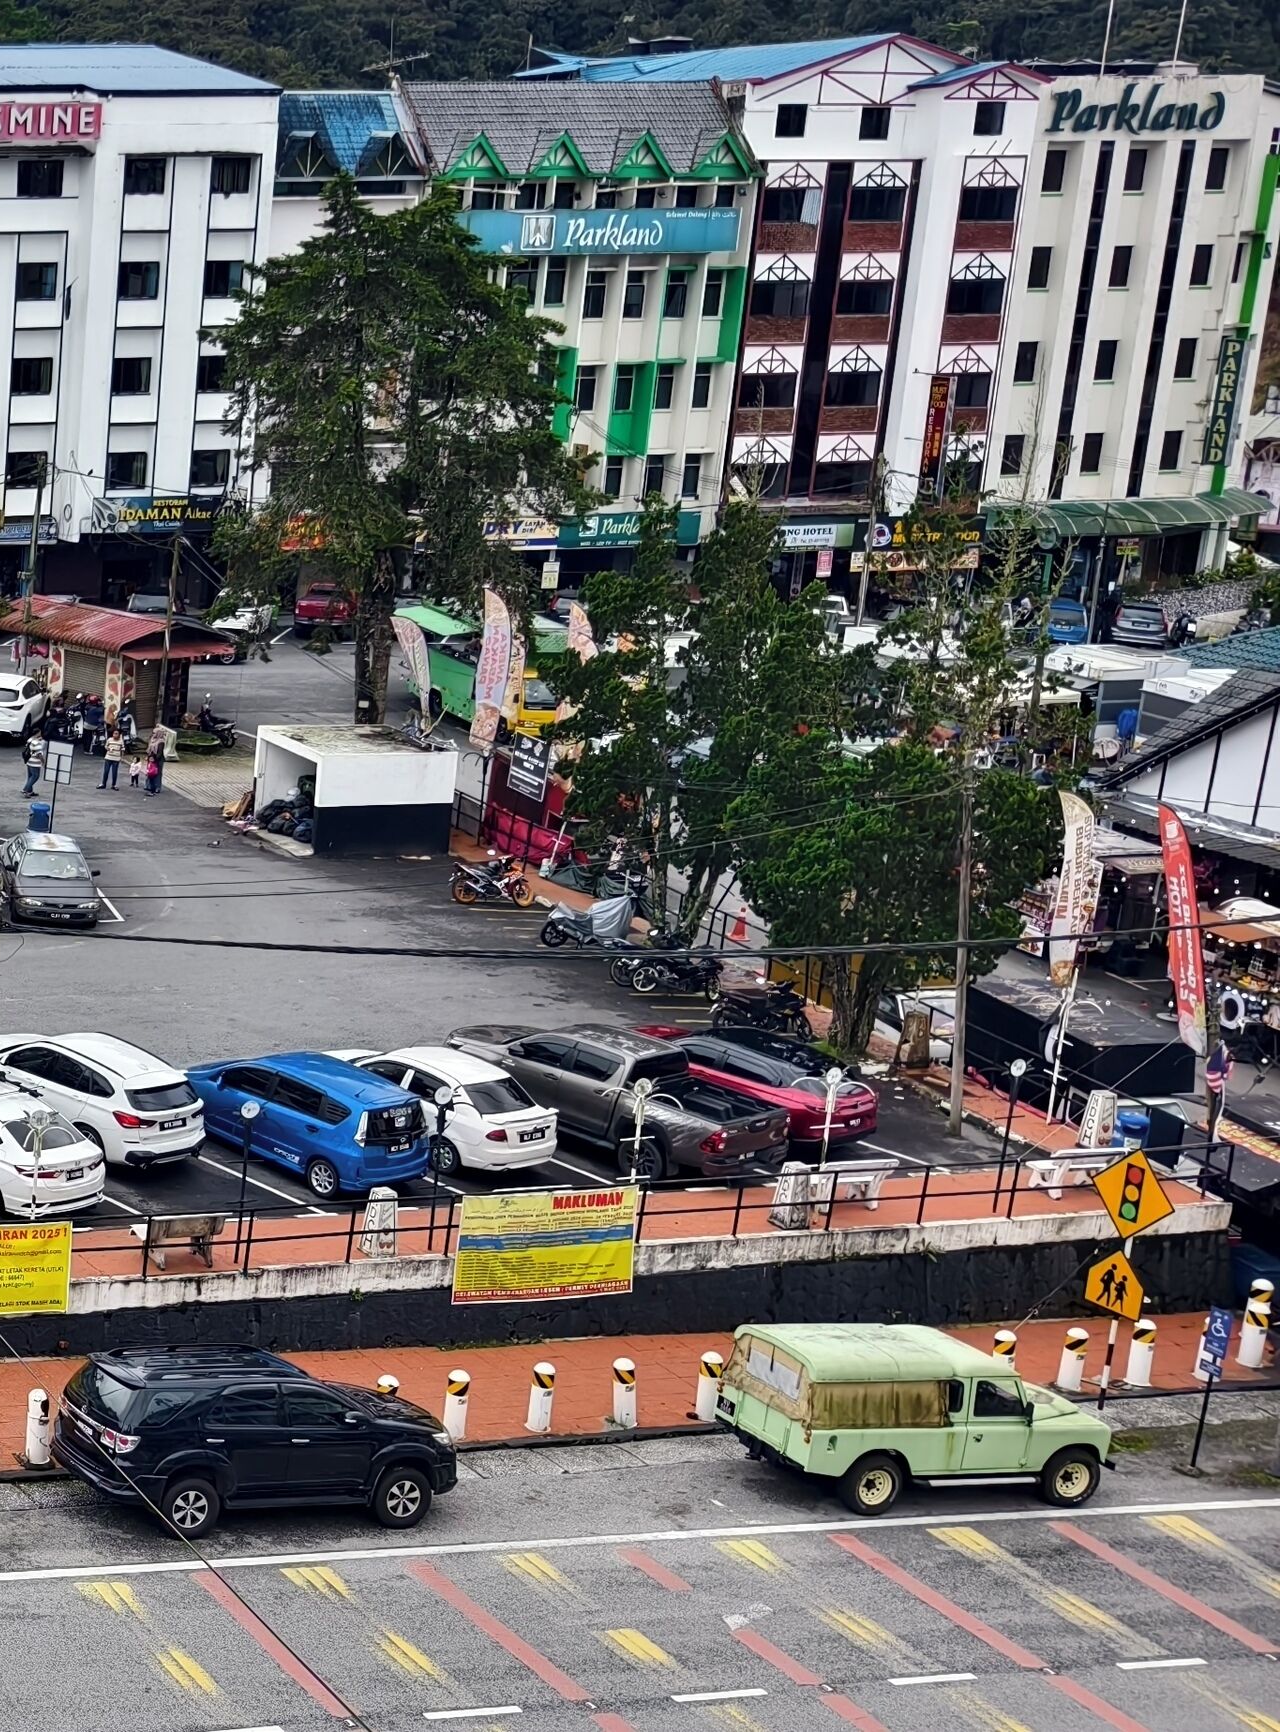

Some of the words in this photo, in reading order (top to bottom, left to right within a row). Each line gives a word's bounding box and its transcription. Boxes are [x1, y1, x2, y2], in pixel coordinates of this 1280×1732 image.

[1045, 82, 1226, 136] Parkland
[563, 215, 663, 250] Parkland
[1208, 341, 1241, 463] PARKLAND
[119, 508, 181, 521] IDAMAN
[803, 527, 834, 536] HOTEL
[553, 1191, 624, 1210] MAKLUMAN
[31, 1228, 61, 1240] 2025
